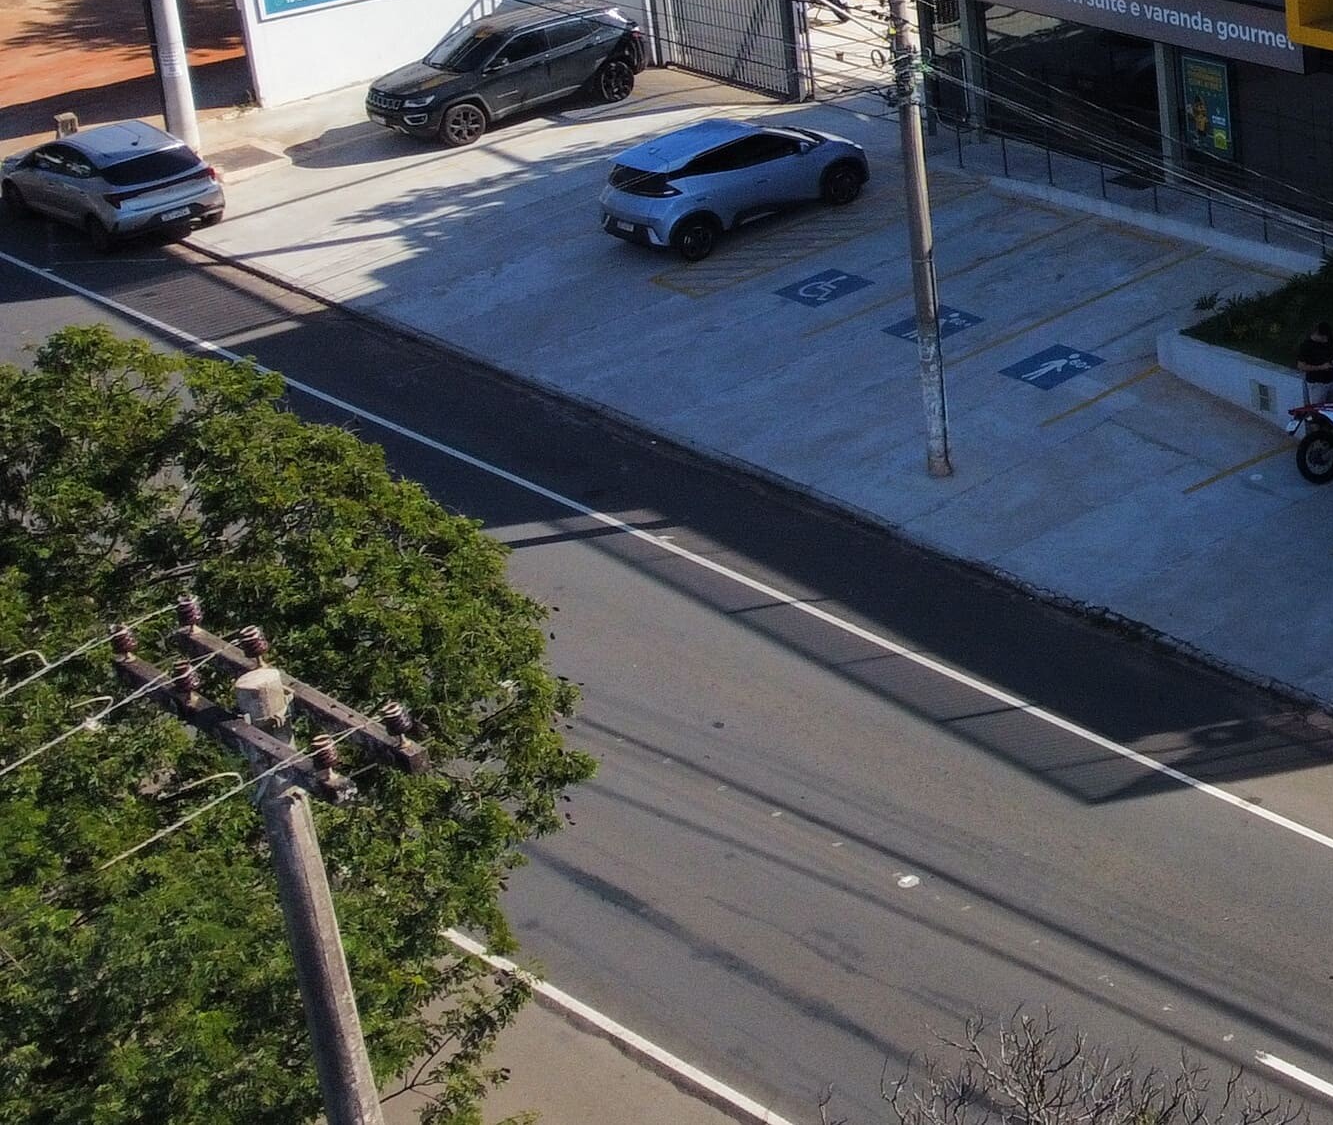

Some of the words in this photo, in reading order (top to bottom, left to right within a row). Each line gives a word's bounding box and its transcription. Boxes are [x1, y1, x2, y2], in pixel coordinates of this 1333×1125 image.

[1130, 1, 1141, 17] e
[1143, 3, 1214, 34] varanda
[1216, 20, 1296, 51] gourmet
